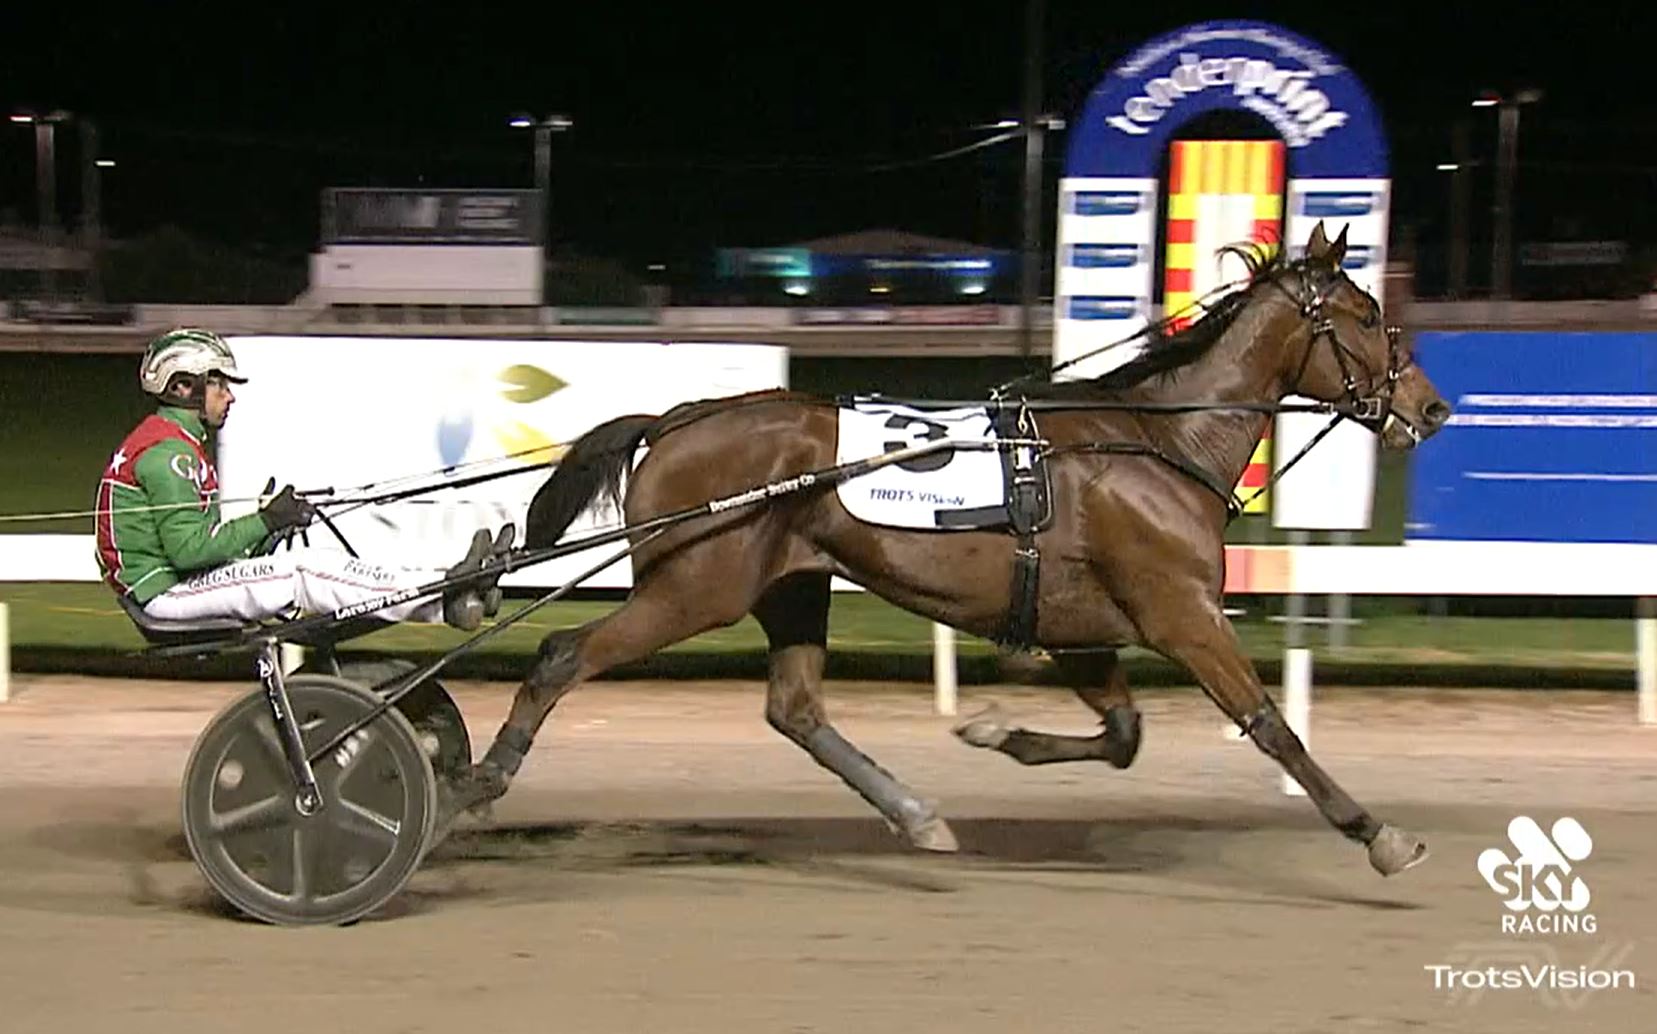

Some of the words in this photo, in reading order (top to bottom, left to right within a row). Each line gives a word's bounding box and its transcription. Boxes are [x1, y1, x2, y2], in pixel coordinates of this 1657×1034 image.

[884, 413, 955, 473] 3
[799, 474, 816, 486] Co
[870, 487, 915, 502] TROTS
[187, 569, 222, 591] GREG
[222, 564, 275, 582] SUGARS
